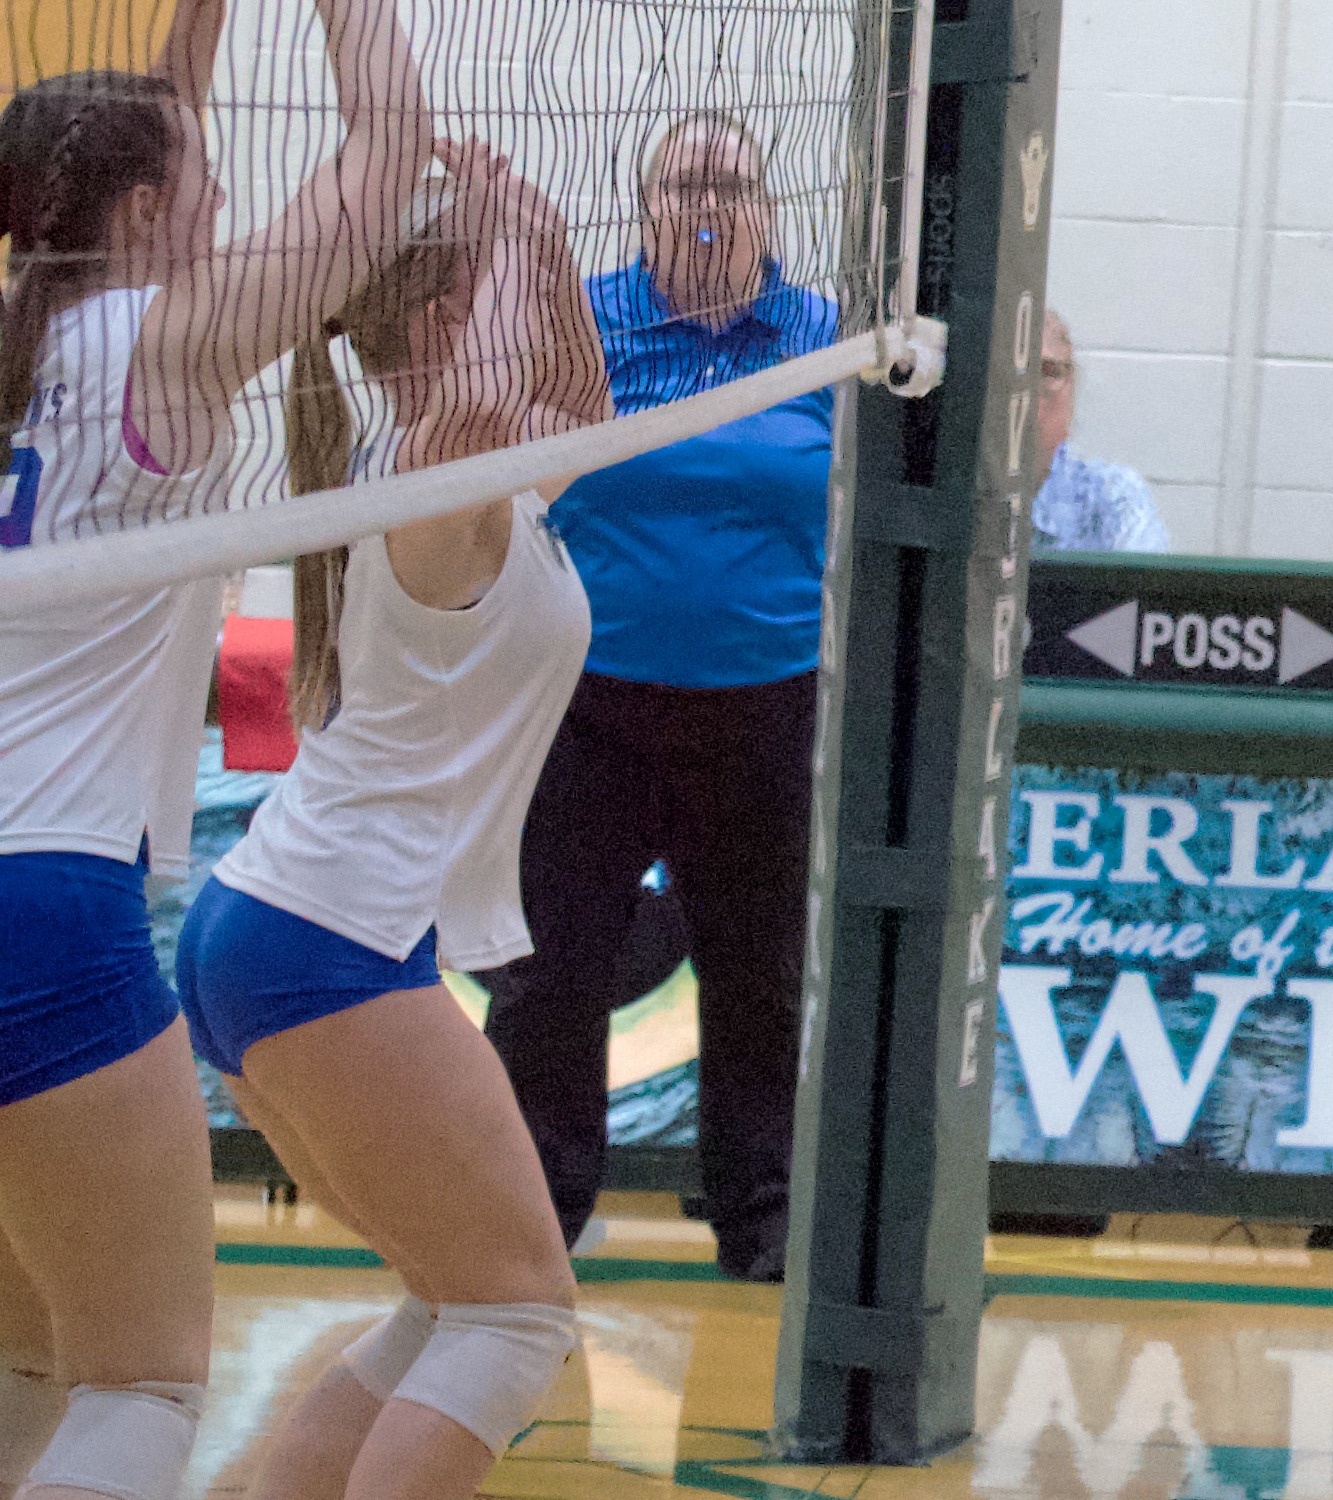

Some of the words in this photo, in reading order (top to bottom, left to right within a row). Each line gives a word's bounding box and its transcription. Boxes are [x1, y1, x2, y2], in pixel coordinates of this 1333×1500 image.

[1138, 612, 1277, 673] POSS
[1010, 890, 1207, 959] Home
[1230, 909, 1301, 982] of
